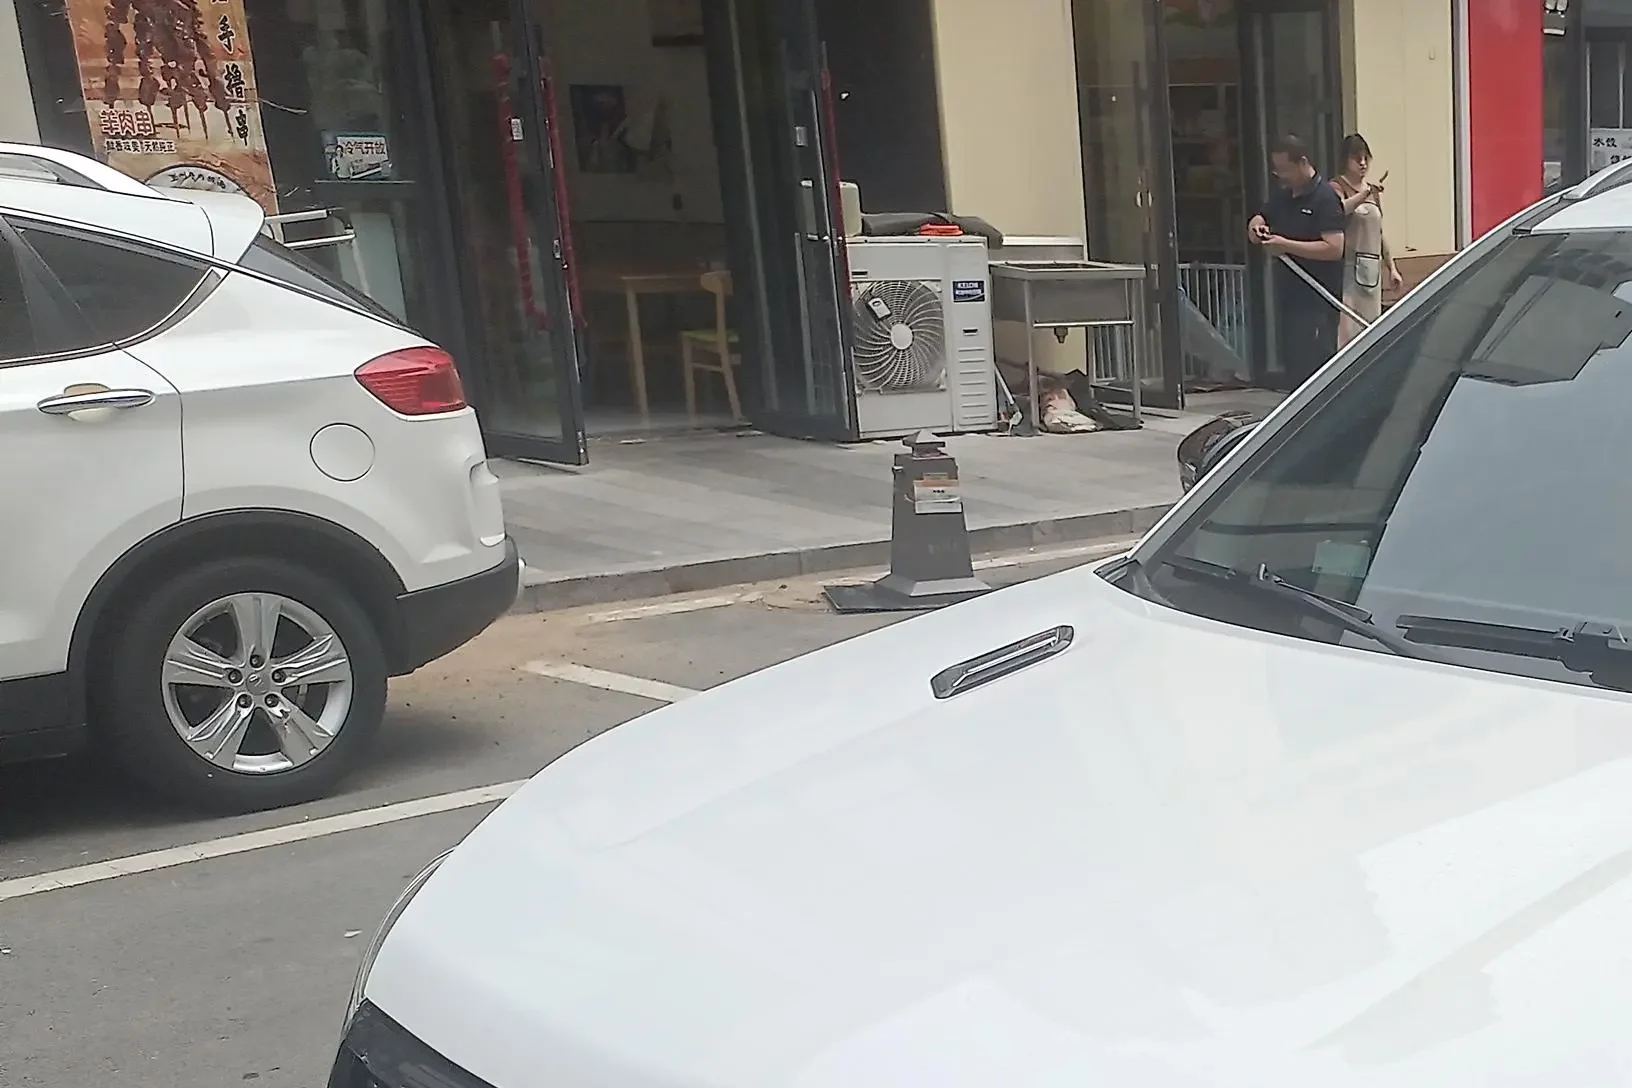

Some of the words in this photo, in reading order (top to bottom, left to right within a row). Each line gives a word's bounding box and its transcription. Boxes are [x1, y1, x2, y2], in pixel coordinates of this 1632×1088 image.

[211, 0, 248, 147] 手撸串
[100, 110, 153, 135] 羊肉串
[343, 141, 386, 155] 冷气开放
